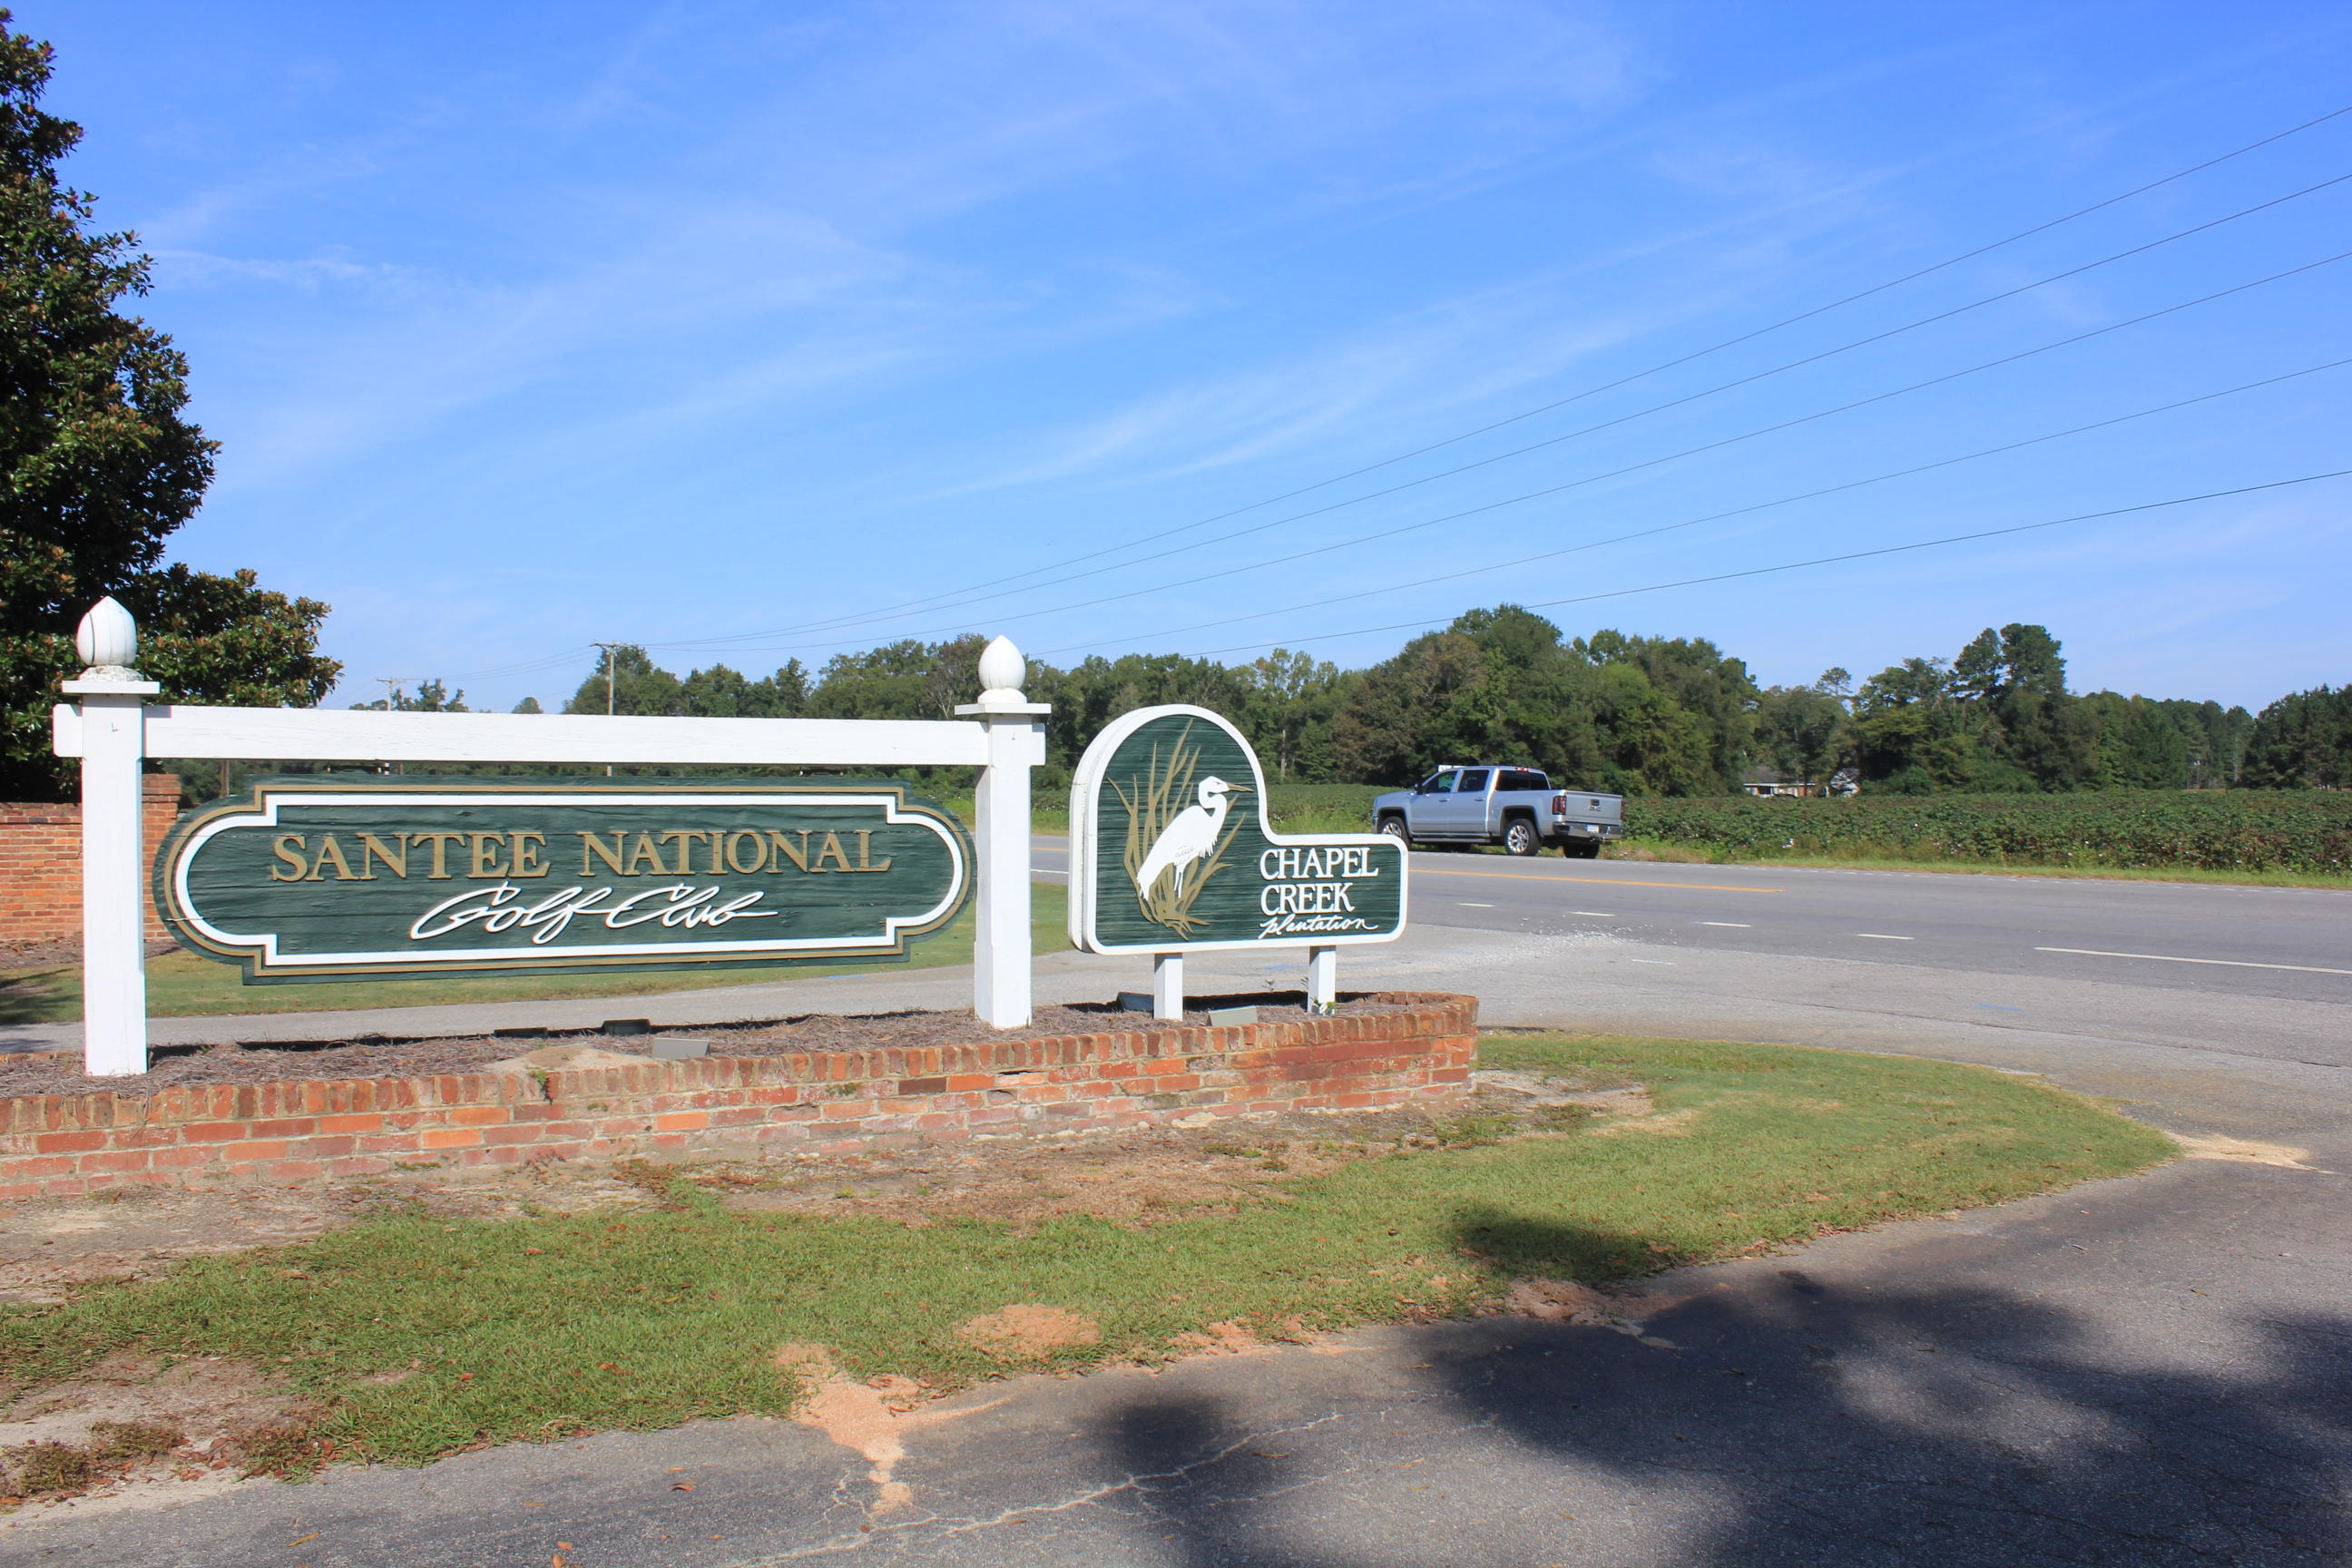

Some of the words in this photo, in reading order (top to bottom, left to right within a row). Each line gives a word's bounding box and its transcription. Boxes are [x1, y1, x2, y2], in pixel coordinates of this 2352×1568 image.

[271, 831, 551, 882] SANTEE
[576, 828, 892, 877] NATIONAL
[1259, 847, 1379, 880] CHAPEL
[410, 880, 633, 945] Golf
[605, 882, 779, 929] Club
[1260, 882, 1356, 916] CREEK
